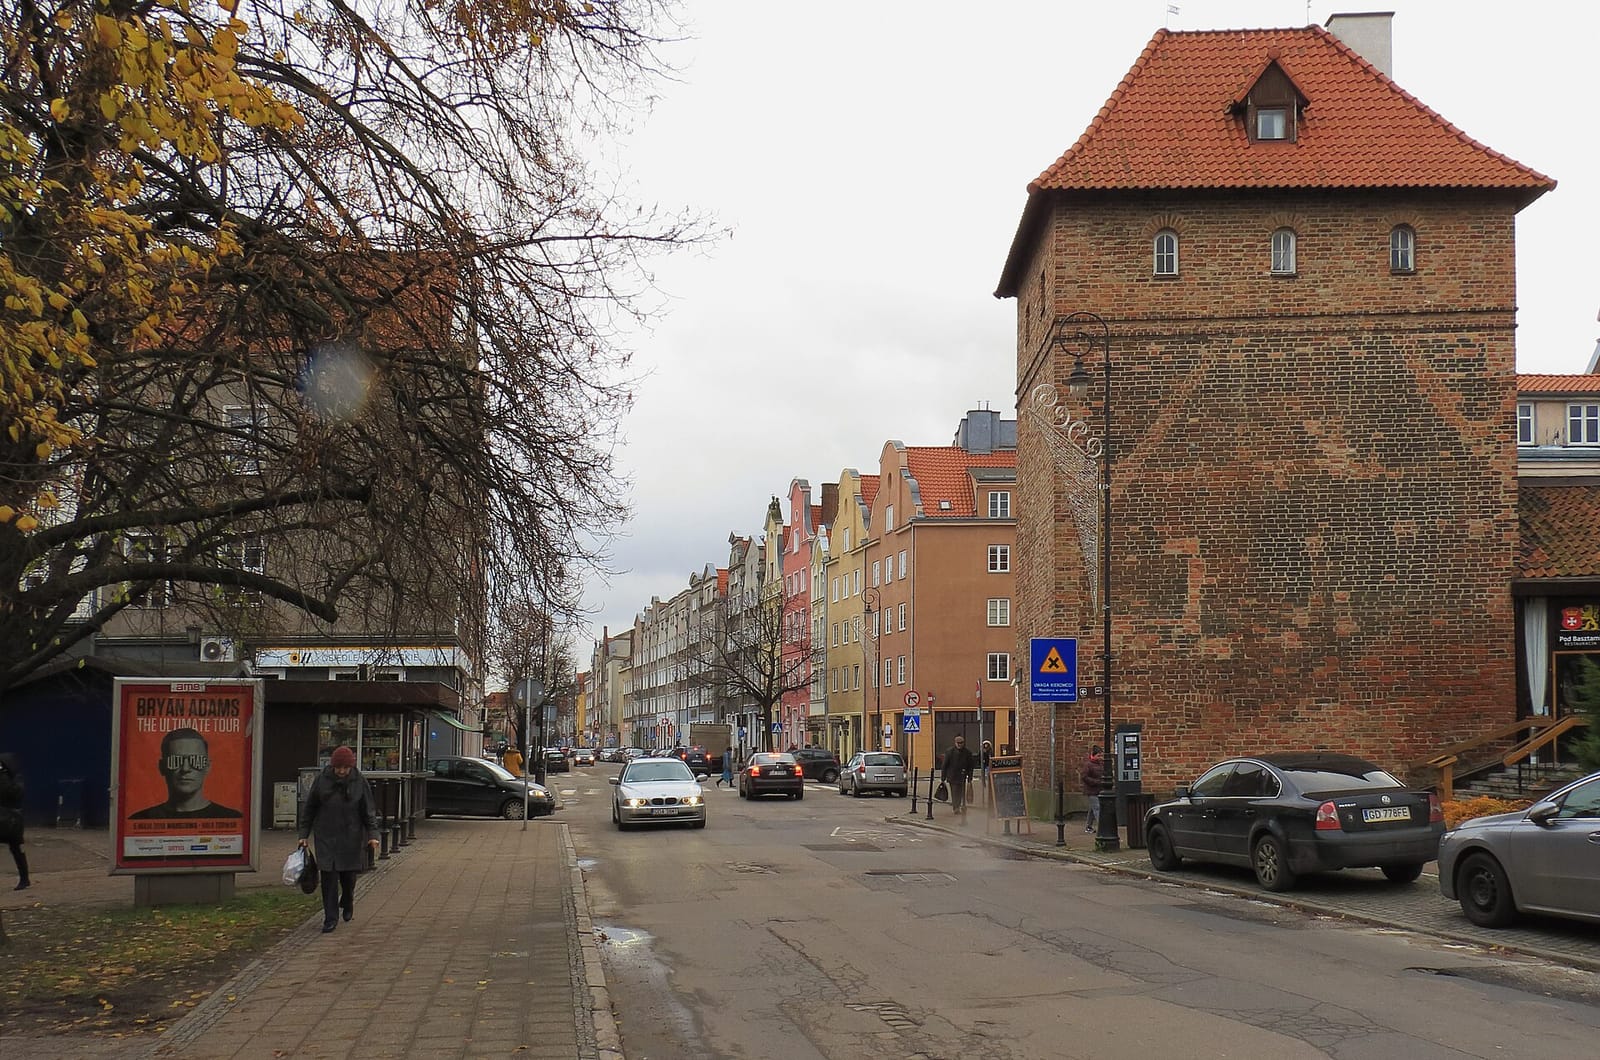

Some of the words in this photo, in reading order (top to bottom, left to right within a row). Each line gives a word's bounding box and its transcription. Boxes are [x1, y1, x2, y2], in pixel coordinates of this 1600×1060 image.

[176, 683, 201, 691] ams
[137, 698, 185, 717] BRYAN
[188, 698, 240, 717] ADAMS
[137, 717, 157, 733] THE
[159, 717, 211, 733] ULTIMATE
[214, 718, 240, 733] TOUR
[1368, 810, 1382, 819] GD
